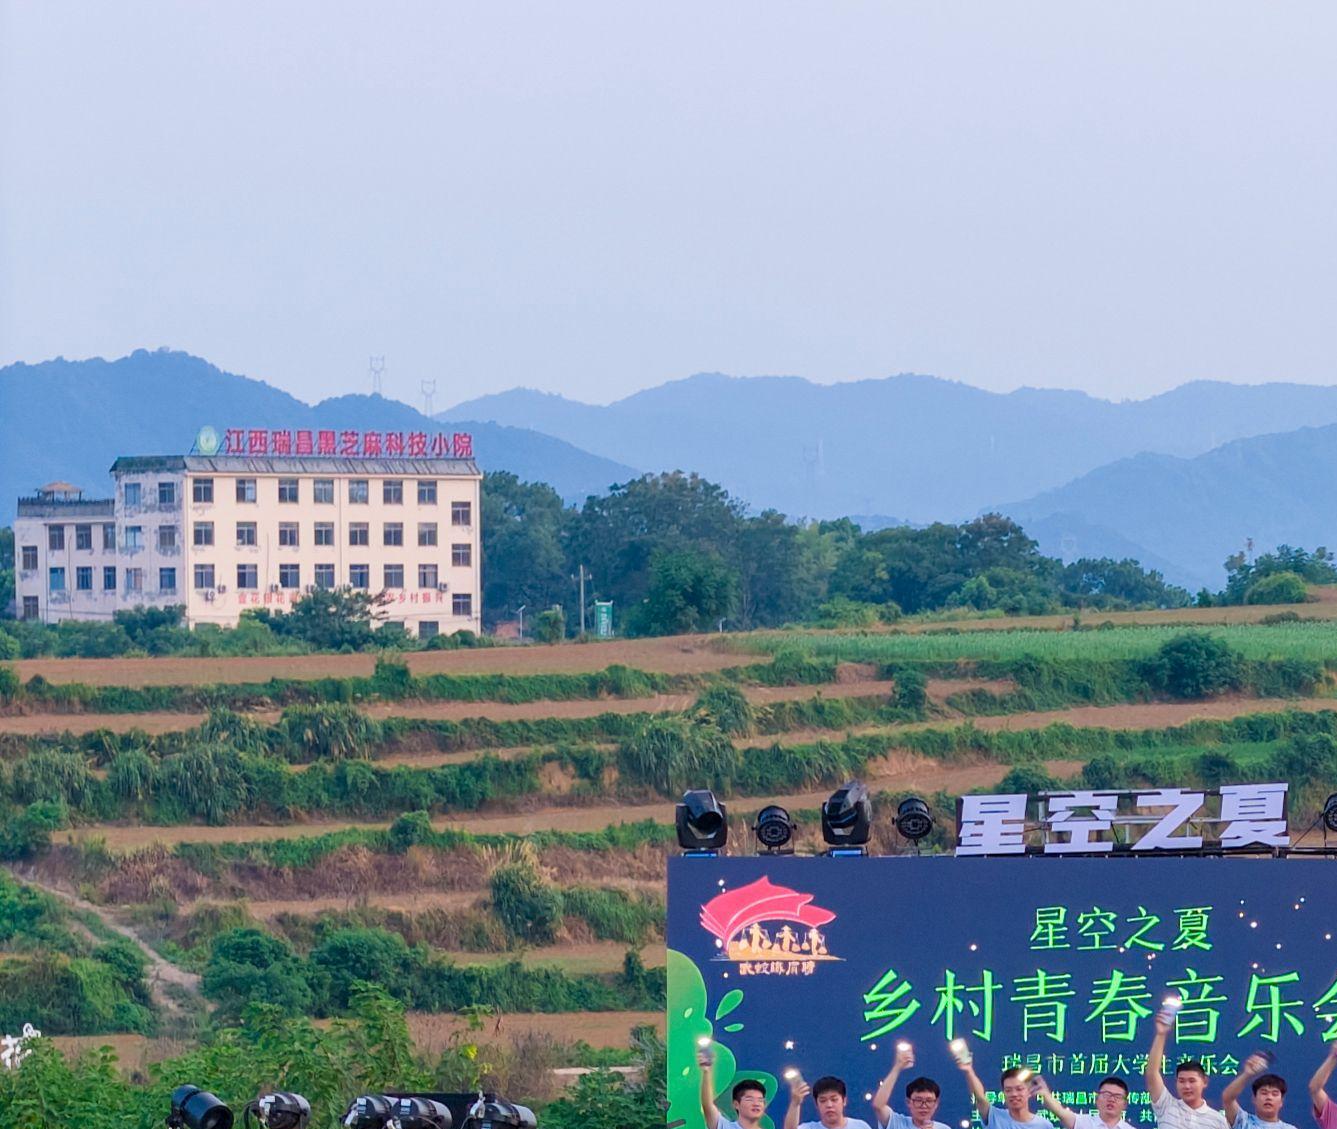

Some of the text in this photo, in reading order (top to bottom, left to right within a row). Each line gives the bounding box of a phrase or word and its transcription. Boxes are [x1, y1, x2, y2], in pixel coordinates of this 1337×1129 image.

[226, 429, 472, 457] 江西瑞昌黑芝麻科技小院
[956, 783, 1290, 854] 星空之夏
[1029, 906, 1213, 951] 星空之夏
